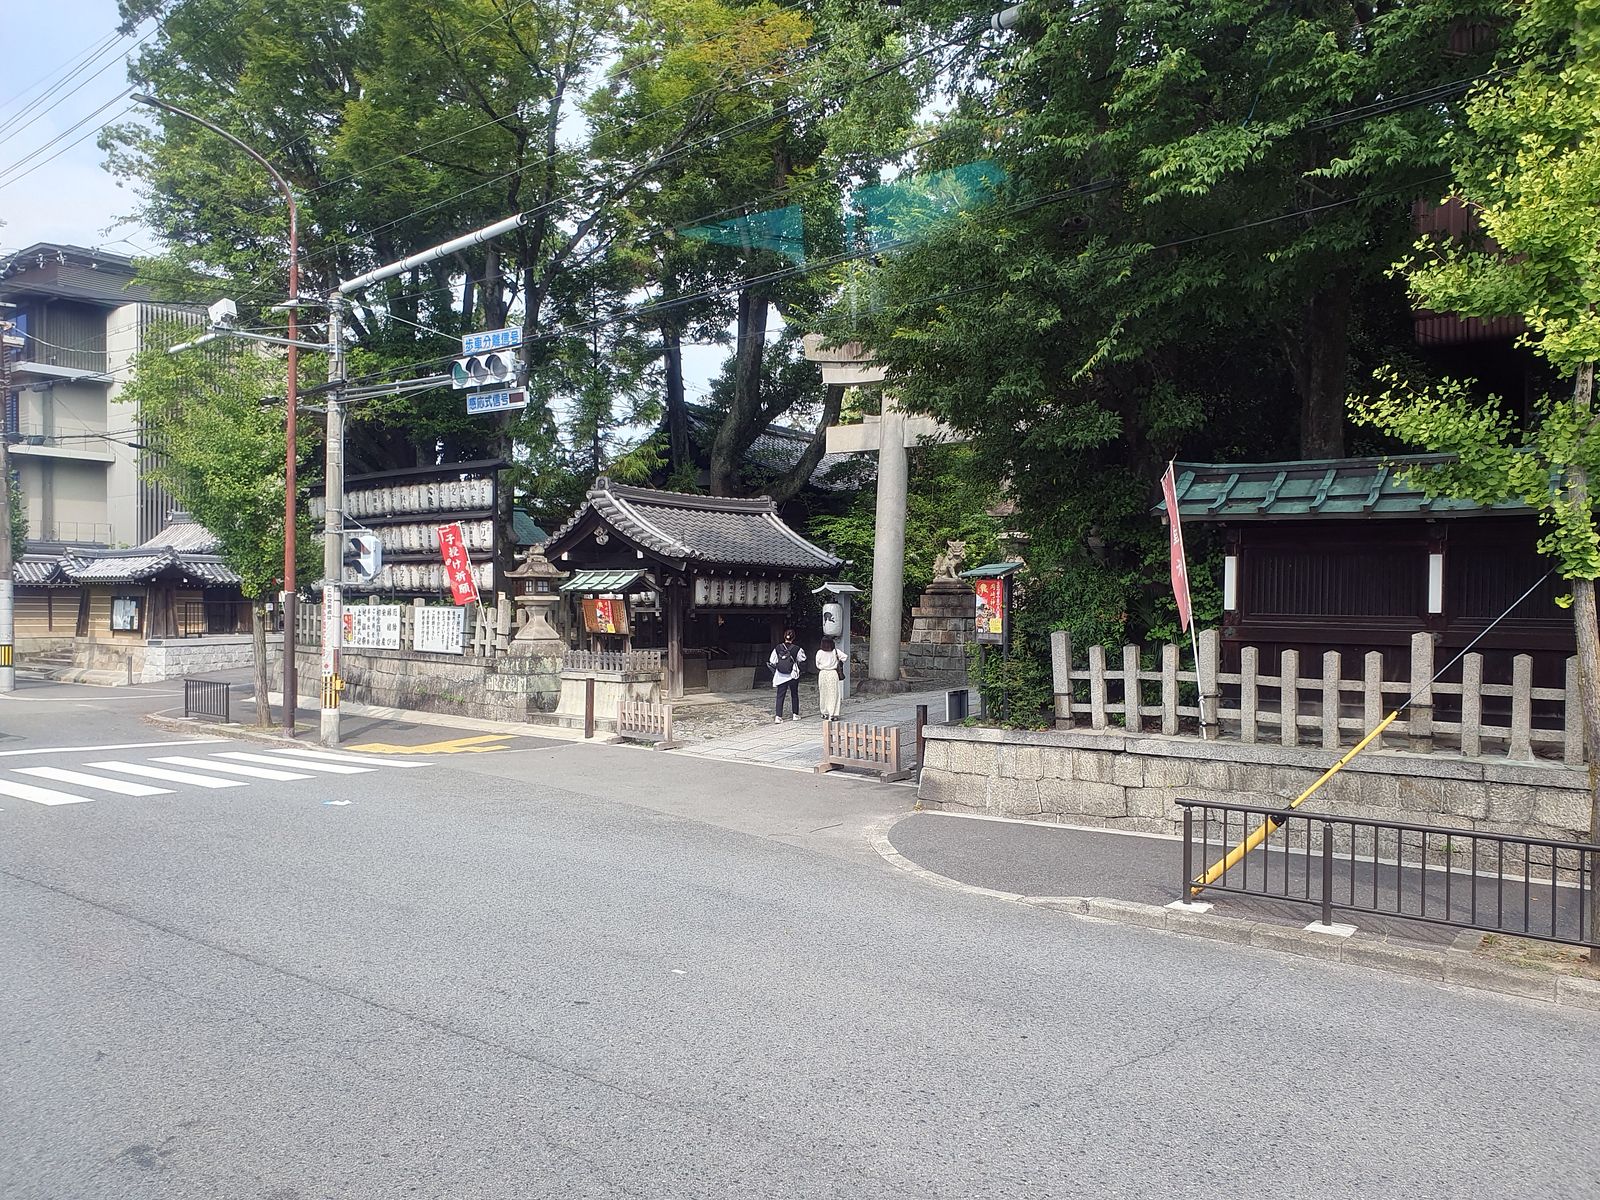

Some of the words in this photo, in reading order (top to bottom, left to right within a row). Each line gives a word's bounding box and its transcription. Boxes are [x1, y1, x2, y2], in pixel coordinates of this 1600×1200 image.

[465, 330, 519, 352] 歩車分離信号
[468, 393, 509, 410] 感応式信号
